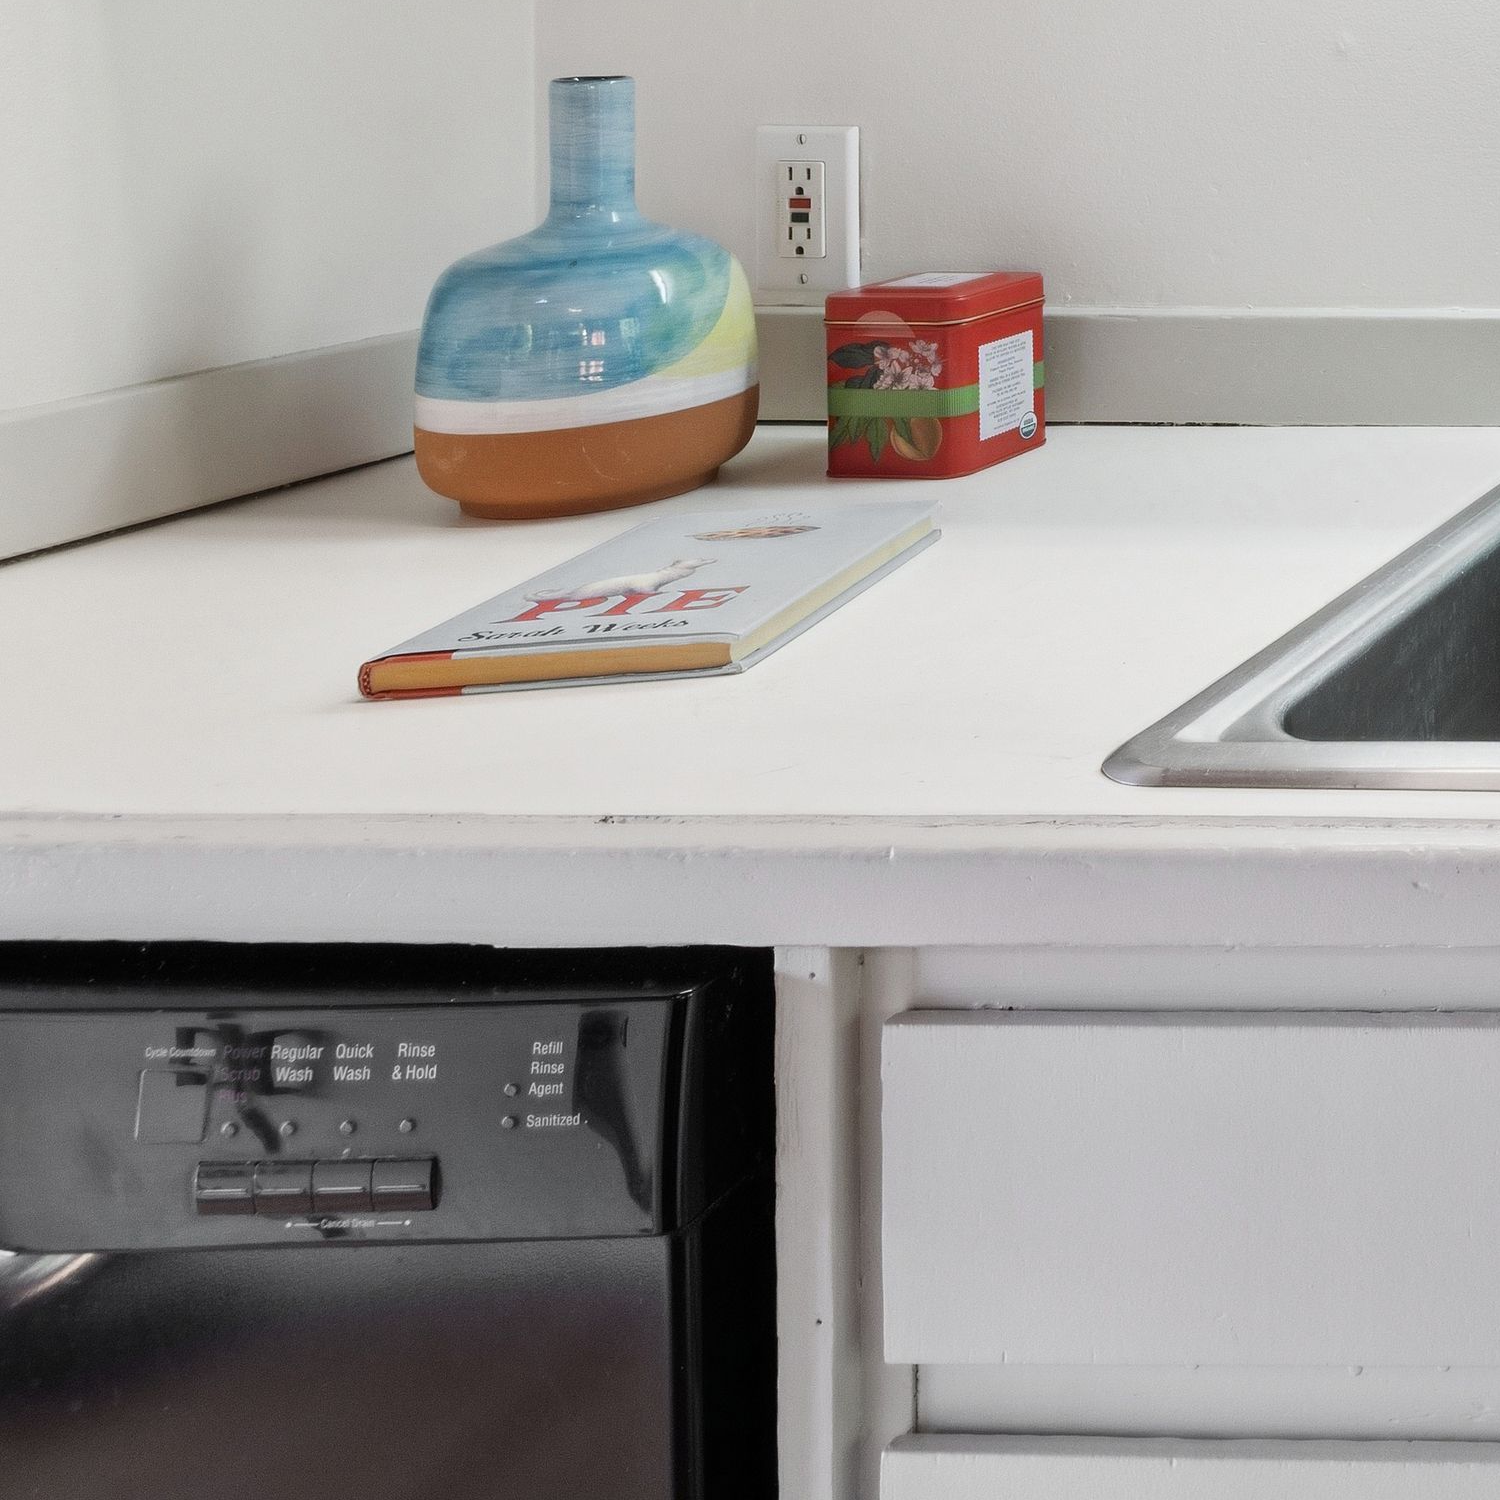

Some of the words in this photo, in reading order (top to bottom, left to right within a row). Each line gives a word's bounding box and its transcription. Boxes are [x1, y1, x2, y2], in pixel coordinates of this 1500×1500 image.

[488, 585, 751, 625] PIE
[456, 625, 568, 643] Sarah
[581, 618, 690, 635] Weeks
[270, 1044, 325, 1062] Regular
[335, 1043, 374, 1060] Quick
[397, 1042, 436, 1059] Rinse
[532, 1041, 563, 1055] Refill
[275, 1067, 314, 1082] Wash
[333, 1065, 371, 1081] Wash
[391, 1065, 402, 1081] &
[405, 1064, 438, 1080] Hold
[530, 1061, 565, 1075] Rinse
[528, 1082, 564, 1098] Agent
[526, 1112, 581, 1128] Sanitized
